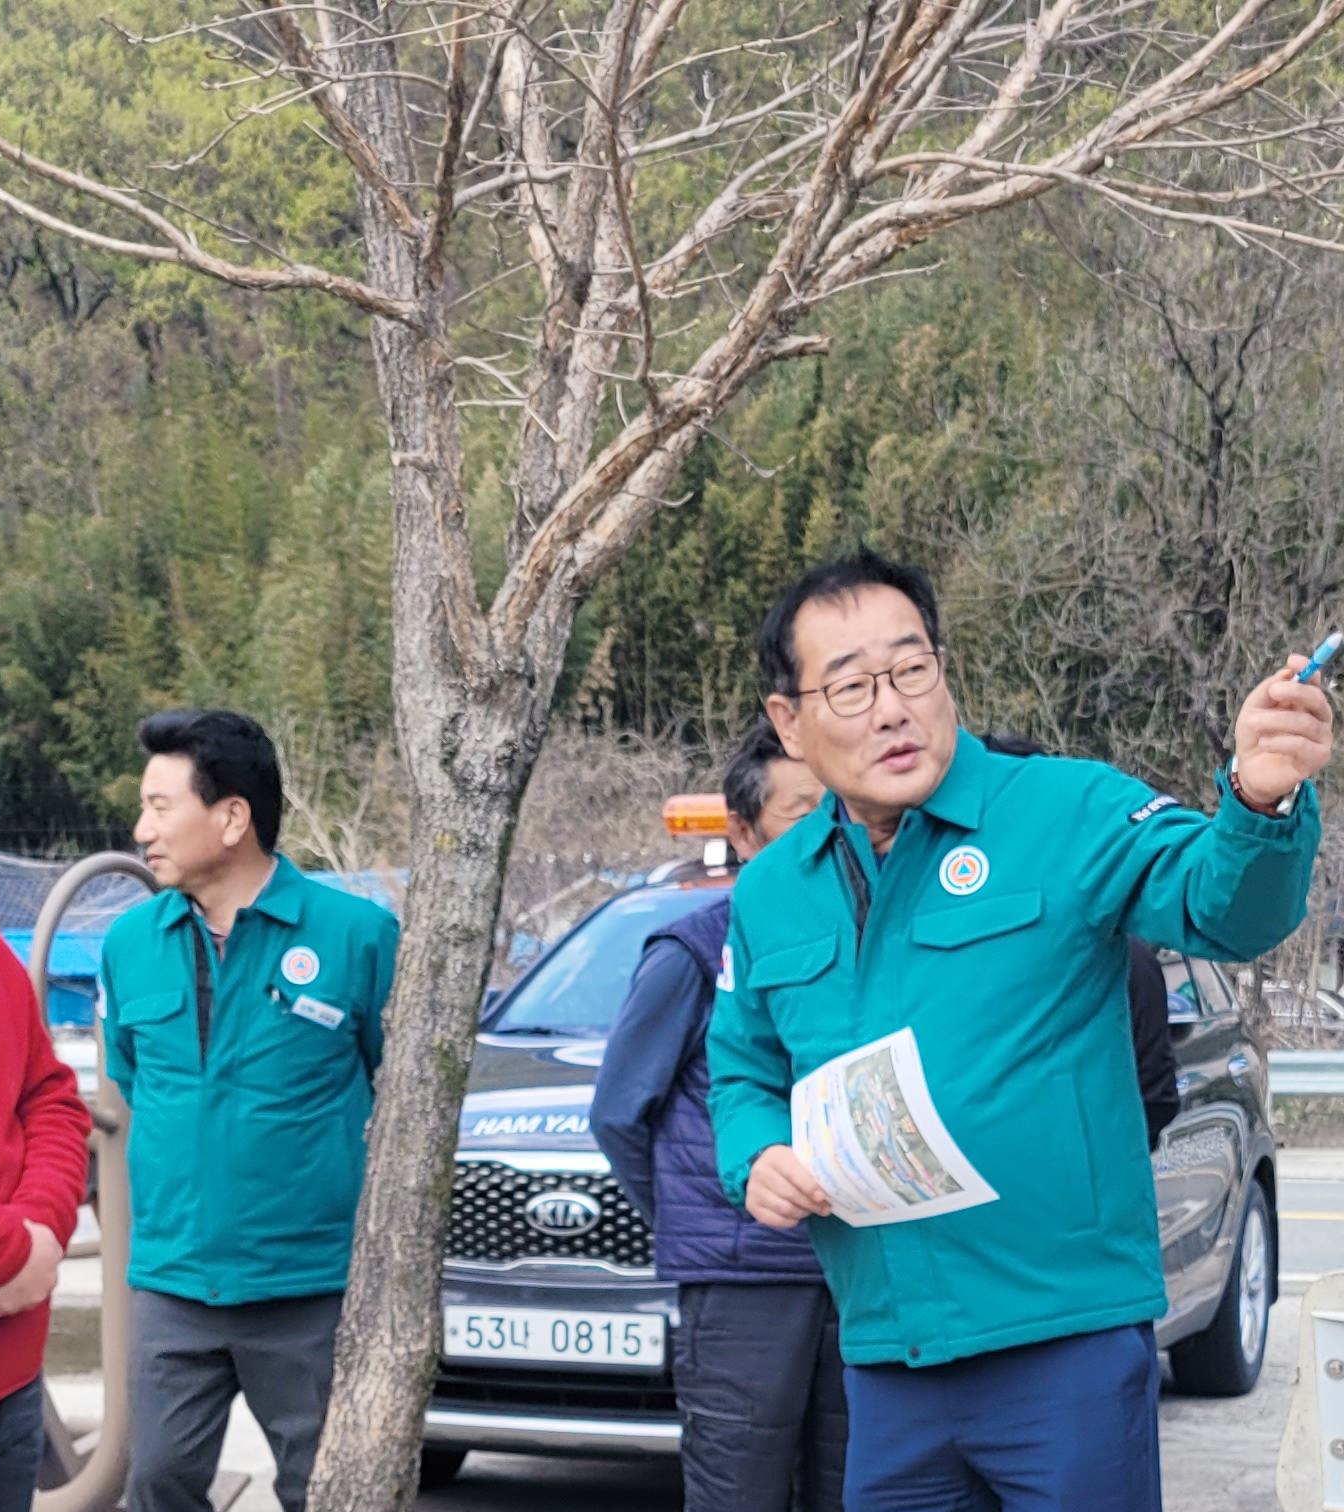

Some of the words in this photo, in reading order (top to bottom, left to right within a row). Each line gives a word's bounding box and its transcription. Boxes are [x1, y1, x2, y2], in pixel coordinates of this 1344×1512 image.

[472, 1114, 543, 1137] HAM
[535, 1200, 588, 1228] KIA
[465, 1315, 529, 1350] 53나
[550, 1319, 642, 1357] 0815
